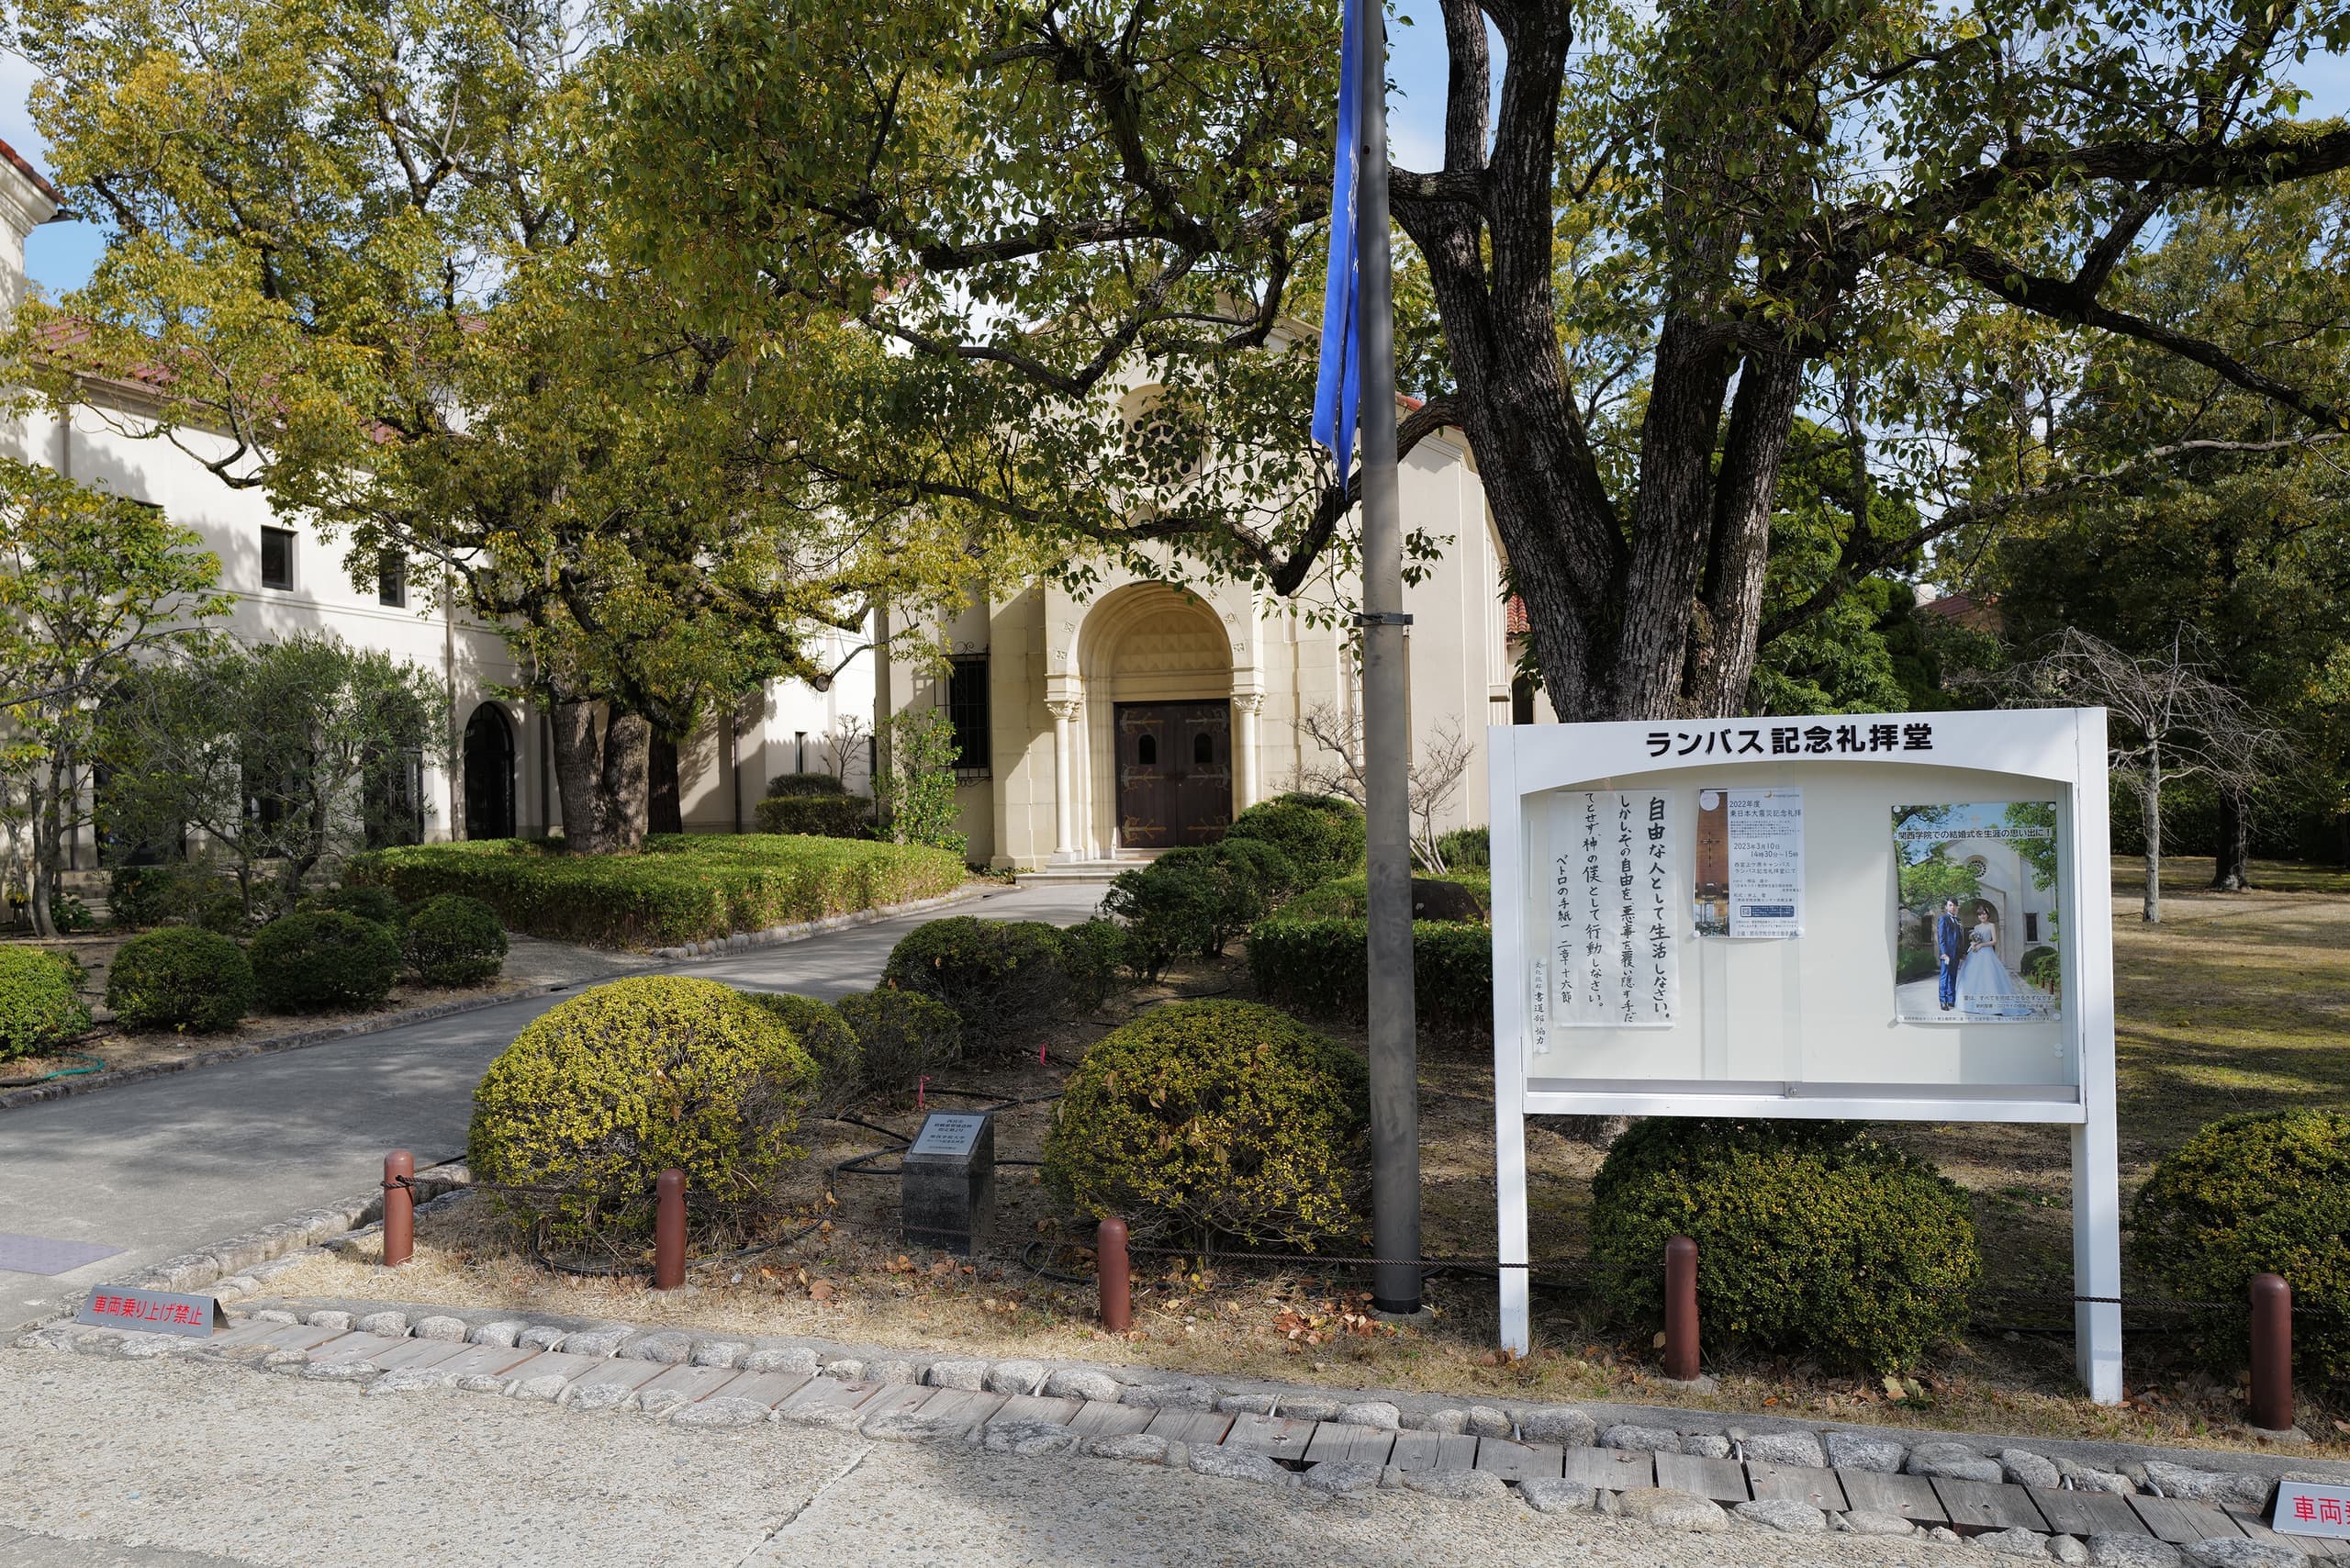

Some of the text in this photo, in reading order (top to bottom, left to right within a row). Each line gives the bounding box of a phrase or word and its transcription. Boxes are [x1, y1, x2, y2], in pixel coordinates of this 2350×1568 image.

[1646, 723, 1933, 757] ランバス記念礼拝堂
[1729, 800, 1761, 809] 2022年度
[1897, 828, 2052, 840] 関西学院での結婚式を生涯の思い出に！
[1647, 796, 1671, 1019] 自由な人として生活しなさい。
[93, 1294, 202, 1326] 車両乗り上げ禁止
[2293, 1495, 2350, 1525] 車両
